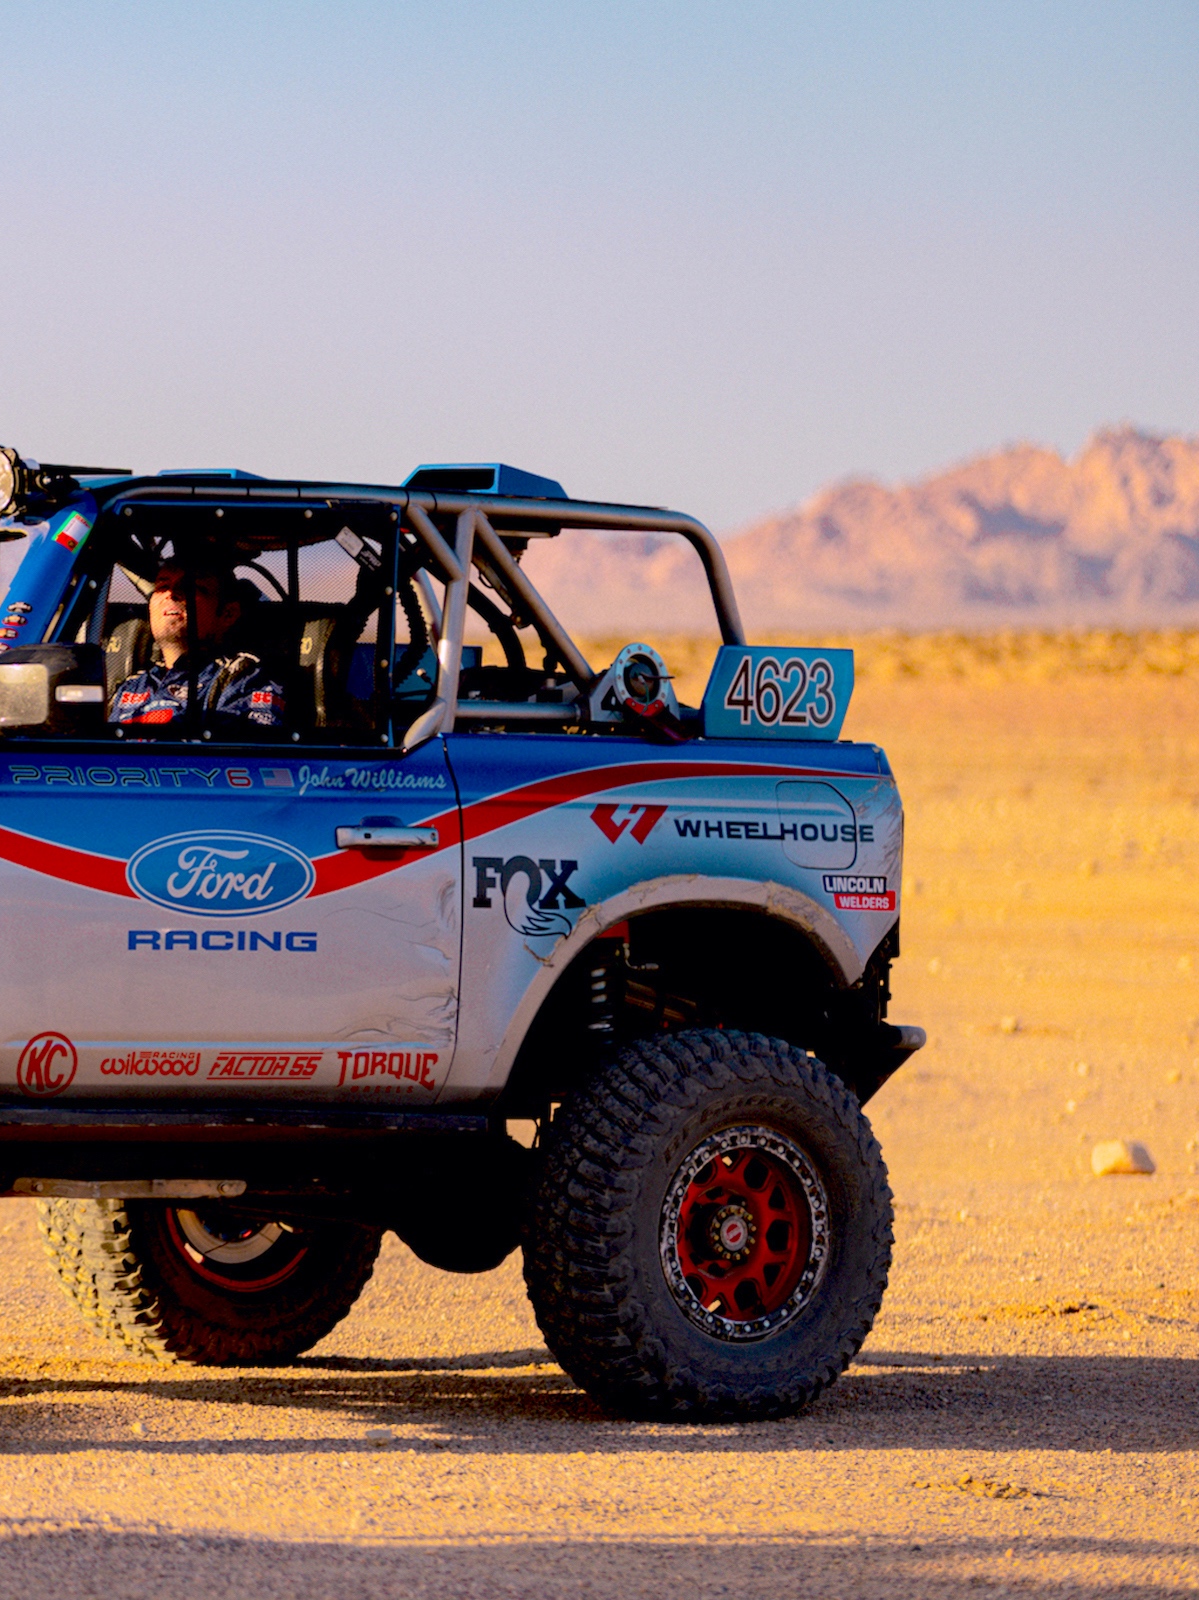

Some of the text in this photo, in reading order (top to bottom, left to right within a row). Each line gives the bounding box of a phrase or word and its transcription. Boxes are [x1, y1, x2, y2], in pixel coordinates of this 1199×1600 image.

[724, 655, 837, 728] 4623
[299, 765, 447, 795] John Williams
[673, 819, 875, 842] WHEELHOUSE
[166, 845, 277, 900] Ford
[472, 854, 587, 910] FOX
[825, 876, 885, 893] LINCOLN
[838, 895, 890, 909] WELDERS
[127, 930, 318, 953] RACING
[24, 1038, 69, 1093] KC
[99, 1052, 201, 1077] wilwood
[151, 1052, 195, 1060] RACING
[208, 1055, 285, 1076] FACTOR
[336, 1051, 439, 1092] TORQUE
